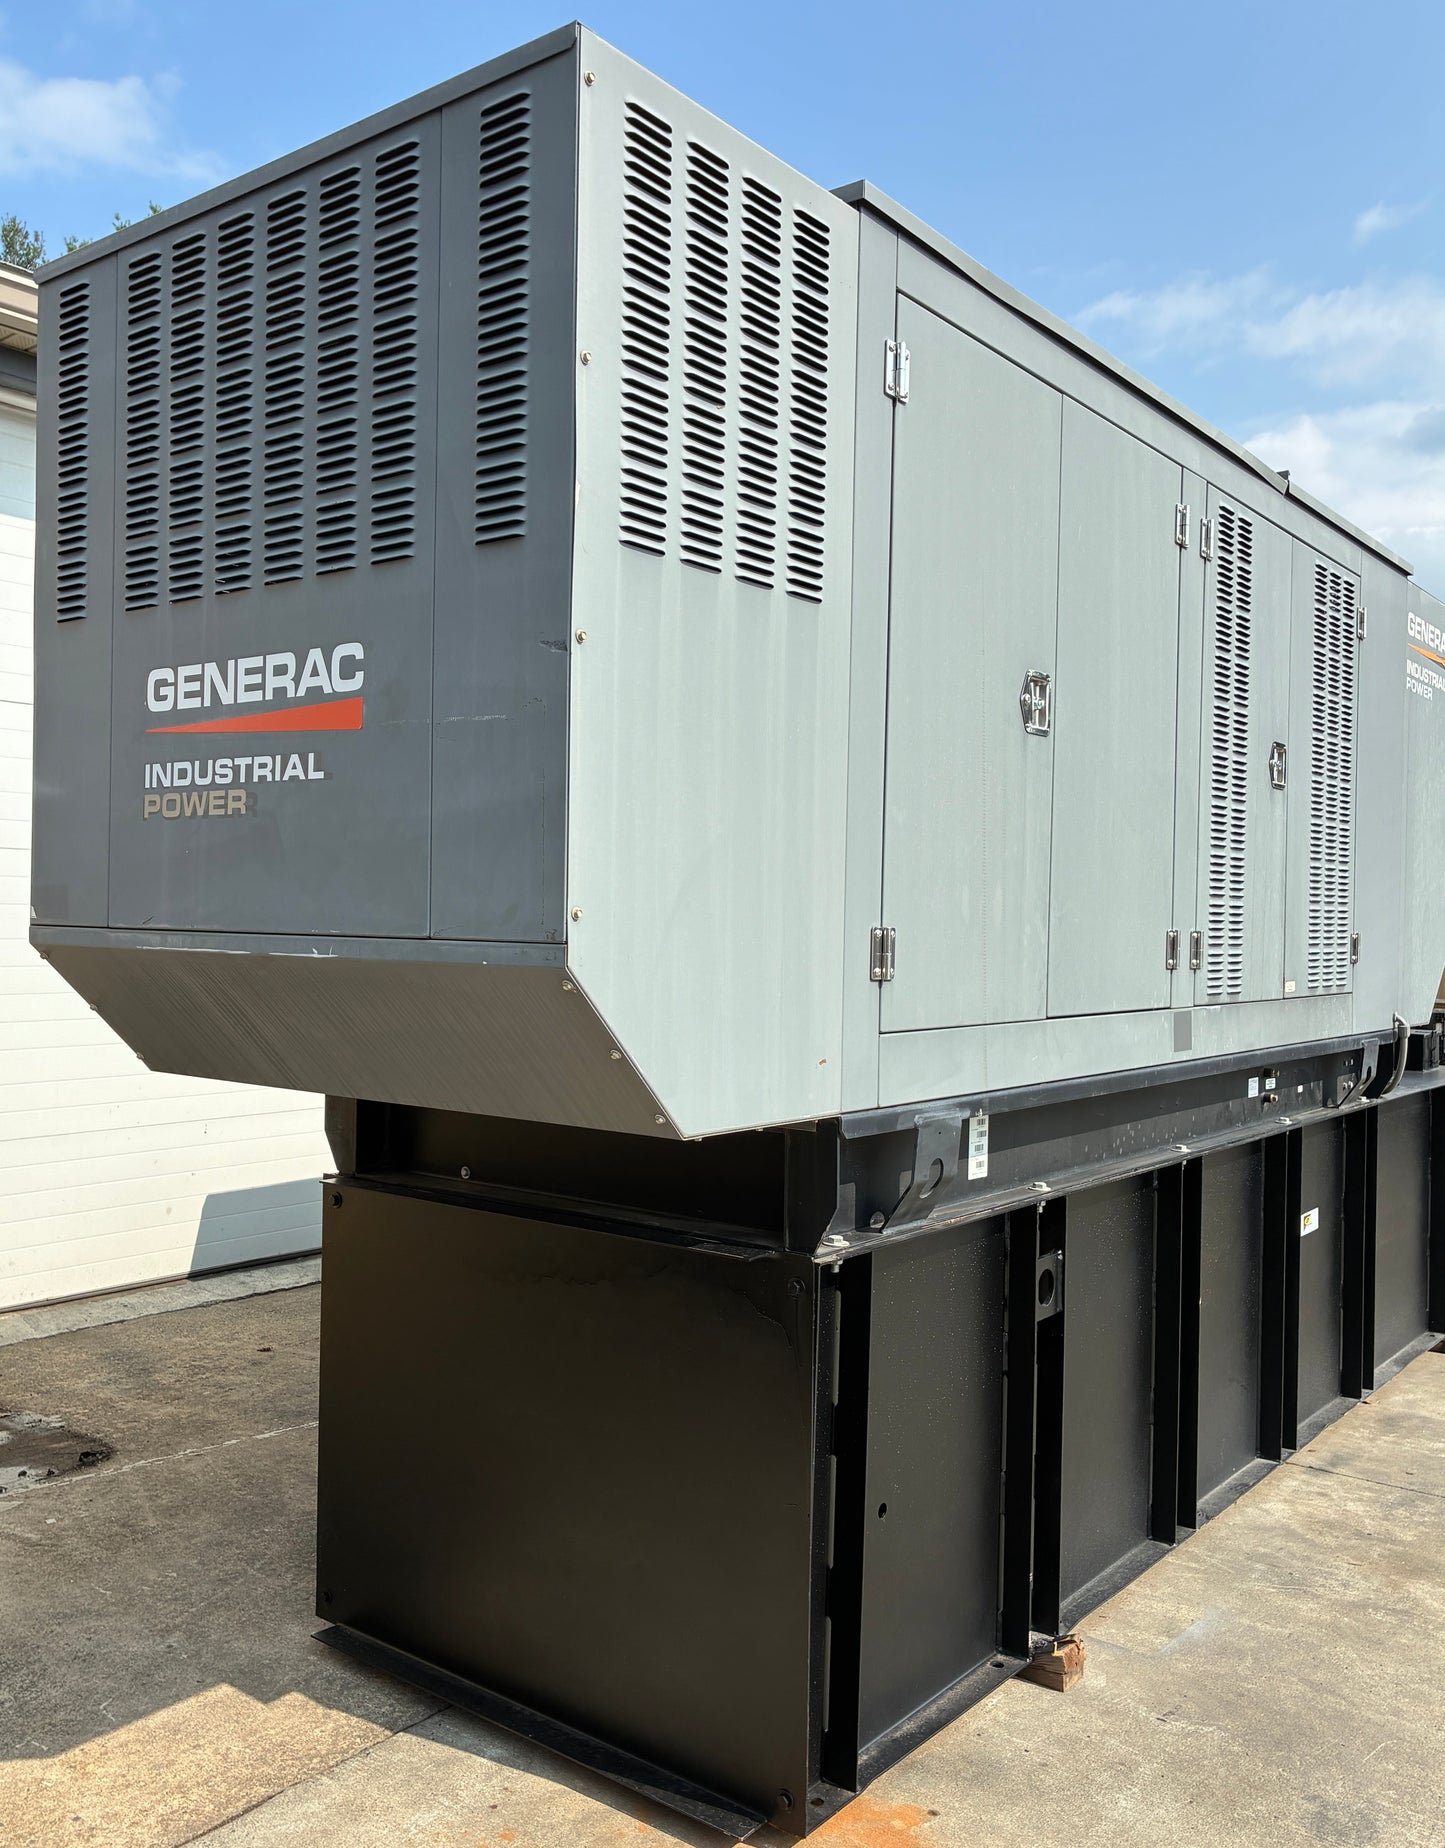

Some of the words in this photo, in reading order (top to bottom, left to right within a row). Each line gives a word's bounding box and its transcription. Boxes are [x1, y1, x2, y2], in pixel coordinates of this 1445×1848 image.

[147, 642, 365, 712] GENERAC
[1406, 676, 1433, 701] POWER
[144, 752, 325, 789] INDUSTRIAL
[143, 788, 248, 820] POWER
